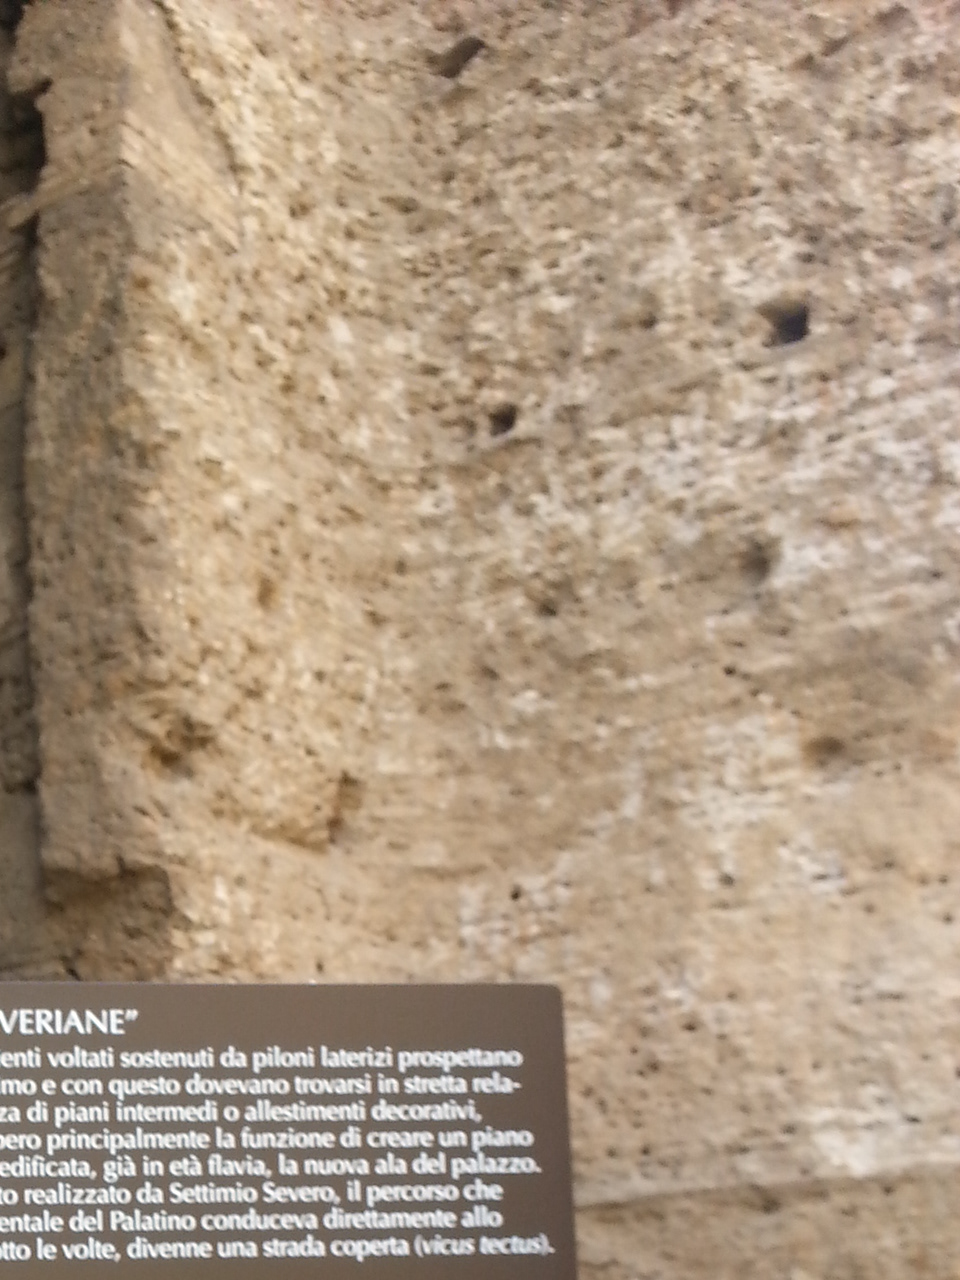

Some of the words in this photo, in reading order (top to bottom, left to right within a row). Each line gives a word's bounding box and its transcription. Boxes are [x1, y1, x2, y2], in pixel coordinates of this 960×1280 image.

[47, 1046, 114, 1068] voltati
[119, 1046, 214, 1068] sostenuti
[252, 1045, 314, 1073] piloni
[320, 1045, 392, 1067] laterizi
[398, 1048, 522, 1072] prospettano
[61, 1079, 102, 1095] con
[108, 1076, 180, 1100] questo
[185, 1072, 290, 1095] dovevano
[294, 1072, 371, 1094] trovarsi
[403, 1075, 467, 1094] stretta
[472, 1072, 520, 1094] rela-
[26, 1101, 48, 1123] di
[54, 1100, 109, 1128] piani
[116, 1100, 217, 1122] intermedi
[244, 1100, 365, 1122] allestimenti
[371, 1099, 481, 1124] decorativi,
[46, 1127, 210, 1155] principalmente
[240, 1126, 335, 1149] funzione
[366, 1132, 434, 1148] creare
[471, 1125, 533, 1153] piano
[103, 1155, 136, 1182] già
[168, 1154, 202, 1176] età
[207, 1154, 271, 1178] flavia,
[304, 1159, 369, 1176] nuova
[374, 1153, 407, 1175] ala
[411, 1153, 446, 1175] del
[451, 1152, 541, 1180] palazzo.
[23, 1182, 131, 1205] realizzato
[169, 1181, 258, 1204] Settimio
[262, 1181, 340, 1205] Severo,
[366, 1186, 459, 1207] percorso
[462, 1179, 503, 1202] che
[68, 1210, 103, 1232] del
[110, 1209, 196, 1232] Palatino
[200, 1208, 318, 1231] conduceva
[322, 1207, 456, 1230] direttamente
[461, 1206, 502, 1229] allo
[61, 1238, 120, 1262] volte,
[126, 1237, 212, 1259] divenne
[217, 1242, 257, 1258] una
[262, 1235, 325, 1258] strada
[330, 1237, 409, 1262] coperta
[414, 1234, 474, 1261] (vicus
[480, 1235, 553, 1256] tectus).
